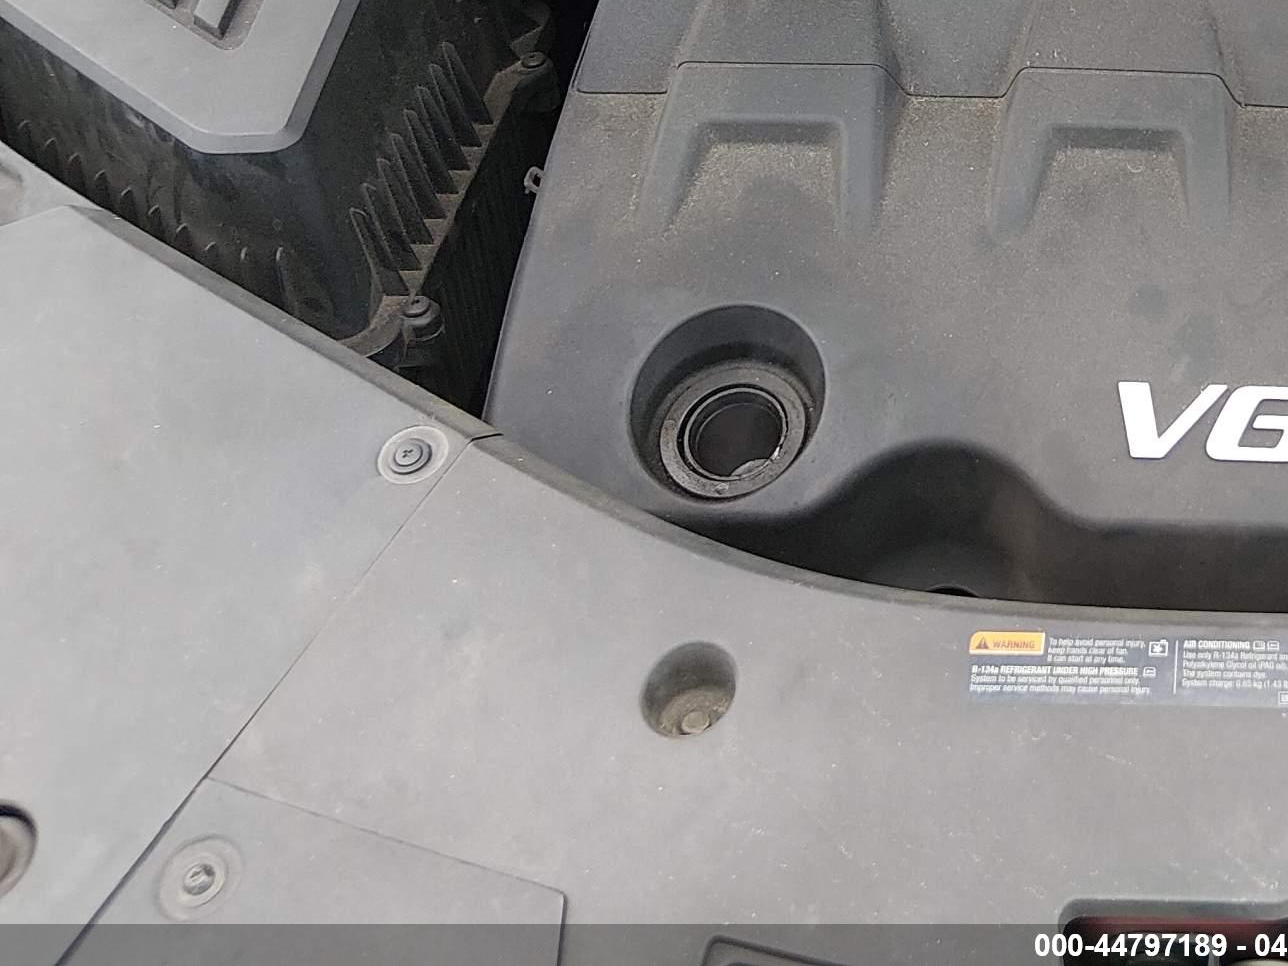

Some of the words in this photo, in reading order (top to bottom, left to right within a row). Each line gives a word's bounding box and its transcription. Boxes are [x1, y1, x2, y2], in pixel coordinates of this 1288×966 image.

[992, 640, 1036, 648] WARNING
[1184, 640, 1196, 649] AIR
[1198, 640, 1250, 650] CONDITIONING
[1000, 666, 1051, 674] REFRIGERANT
[1053, 666, 1078, 674] UNDER
[1100, 667, 1138, 675] PRESSURE
